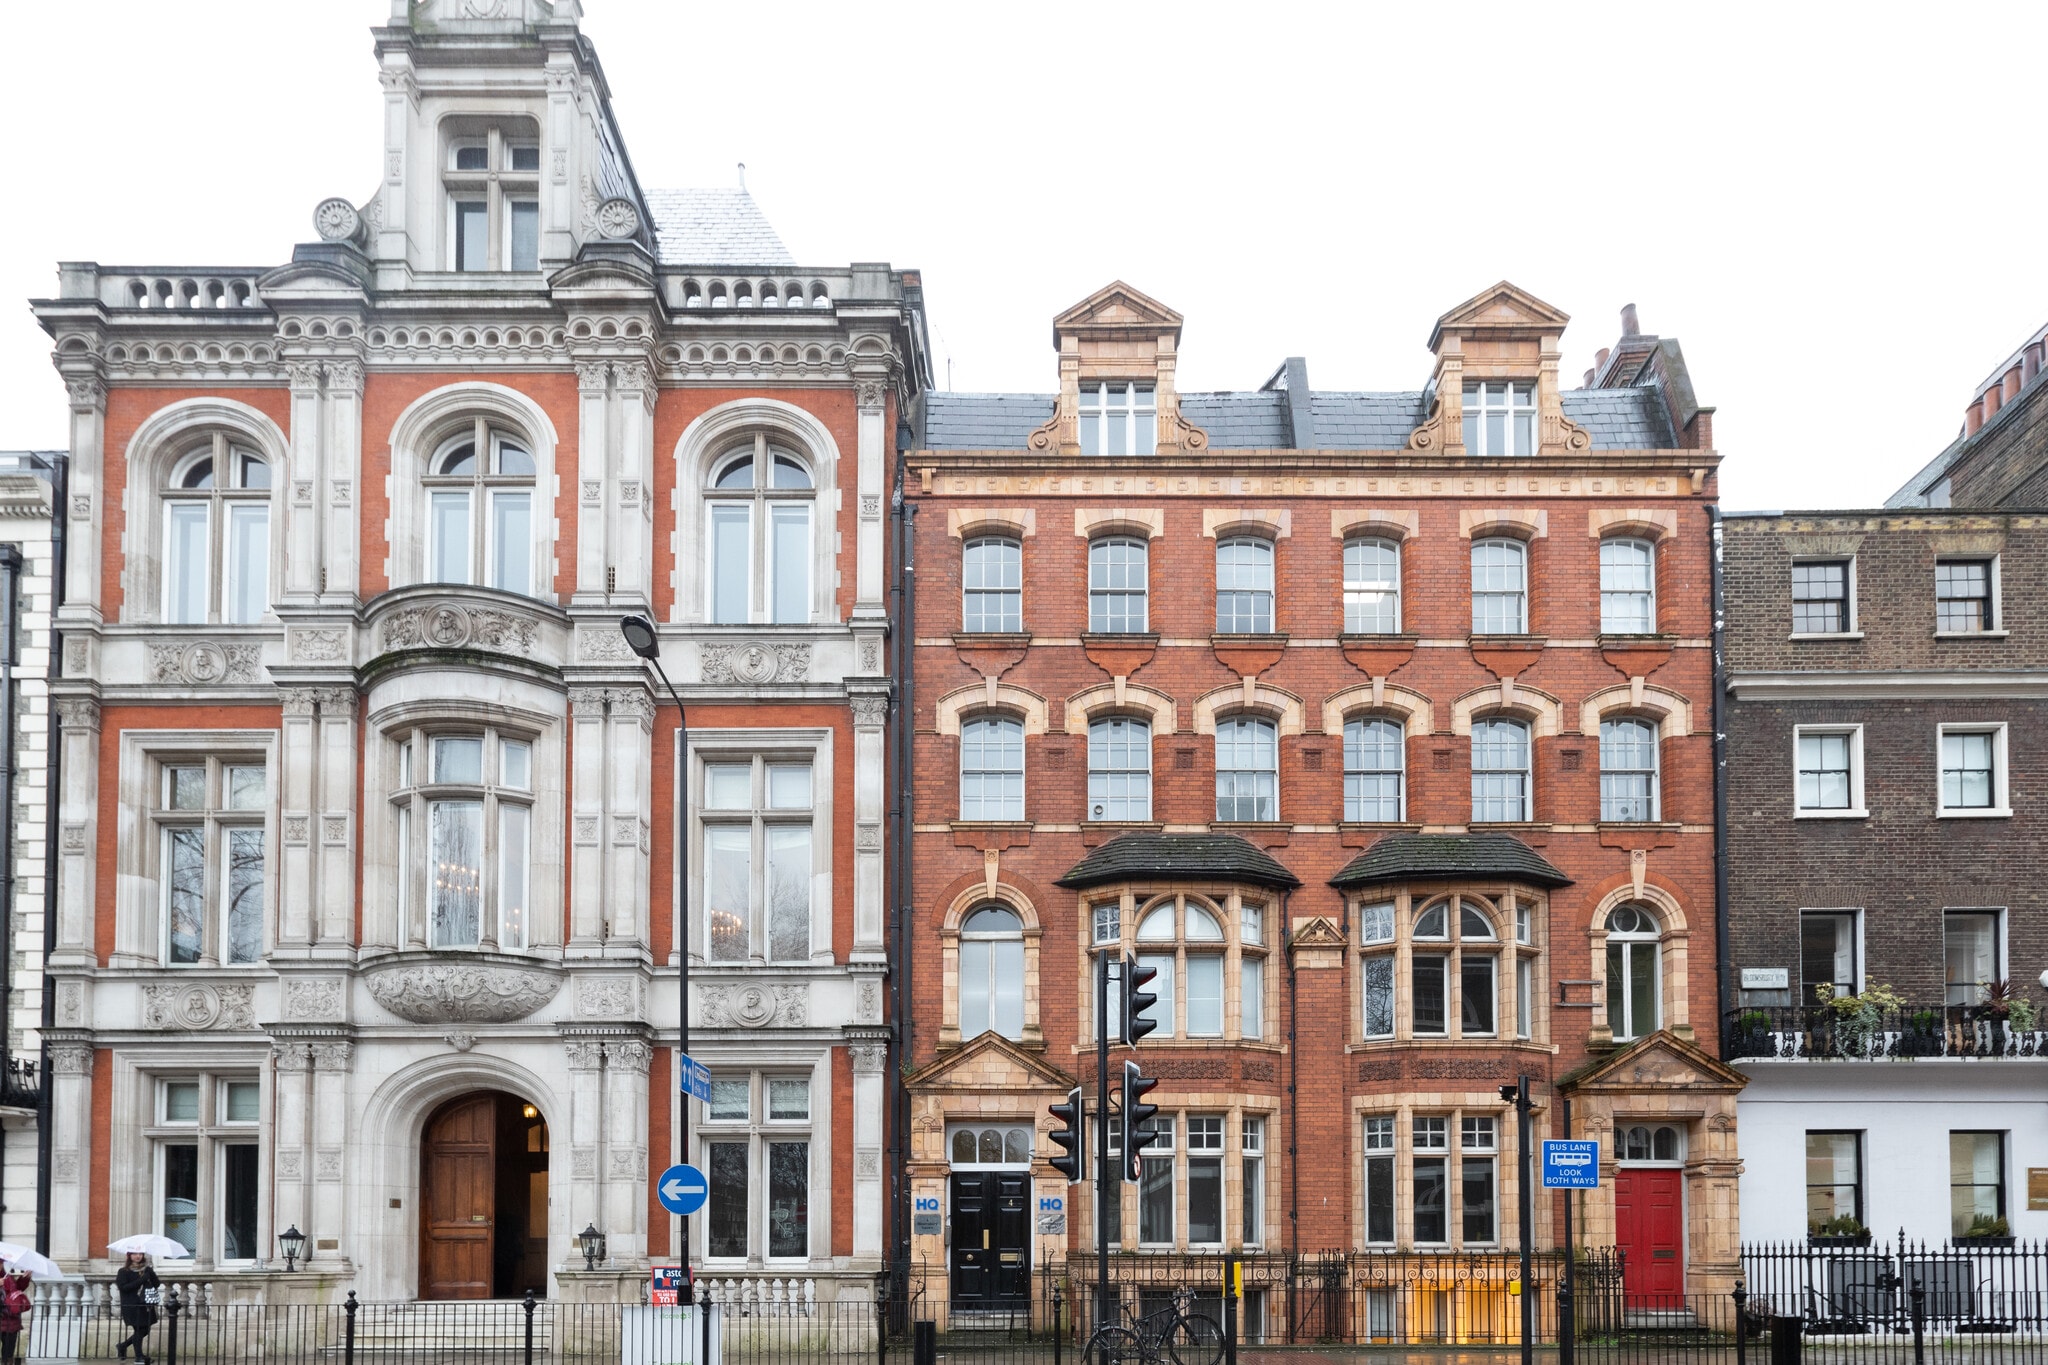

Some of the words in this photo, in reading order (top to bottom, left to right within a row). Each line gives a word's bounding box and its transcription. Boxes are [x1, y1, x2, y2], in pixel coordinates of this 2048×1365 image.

[1549, 1143, 1567, 1151] BUS
[1570, 1143, 1592, 1151] LANE
[1546, 1176, 1569, 1184] BOTH
[1572, 1177, 1595, 1185] WAYS
[916, 1198, 939, 1211] HQ
[1008, 1199, 1013, 1207] 4
[1040, 1198, 1063, 1211] HQ
[666, 1269, 682, 1277] asto
